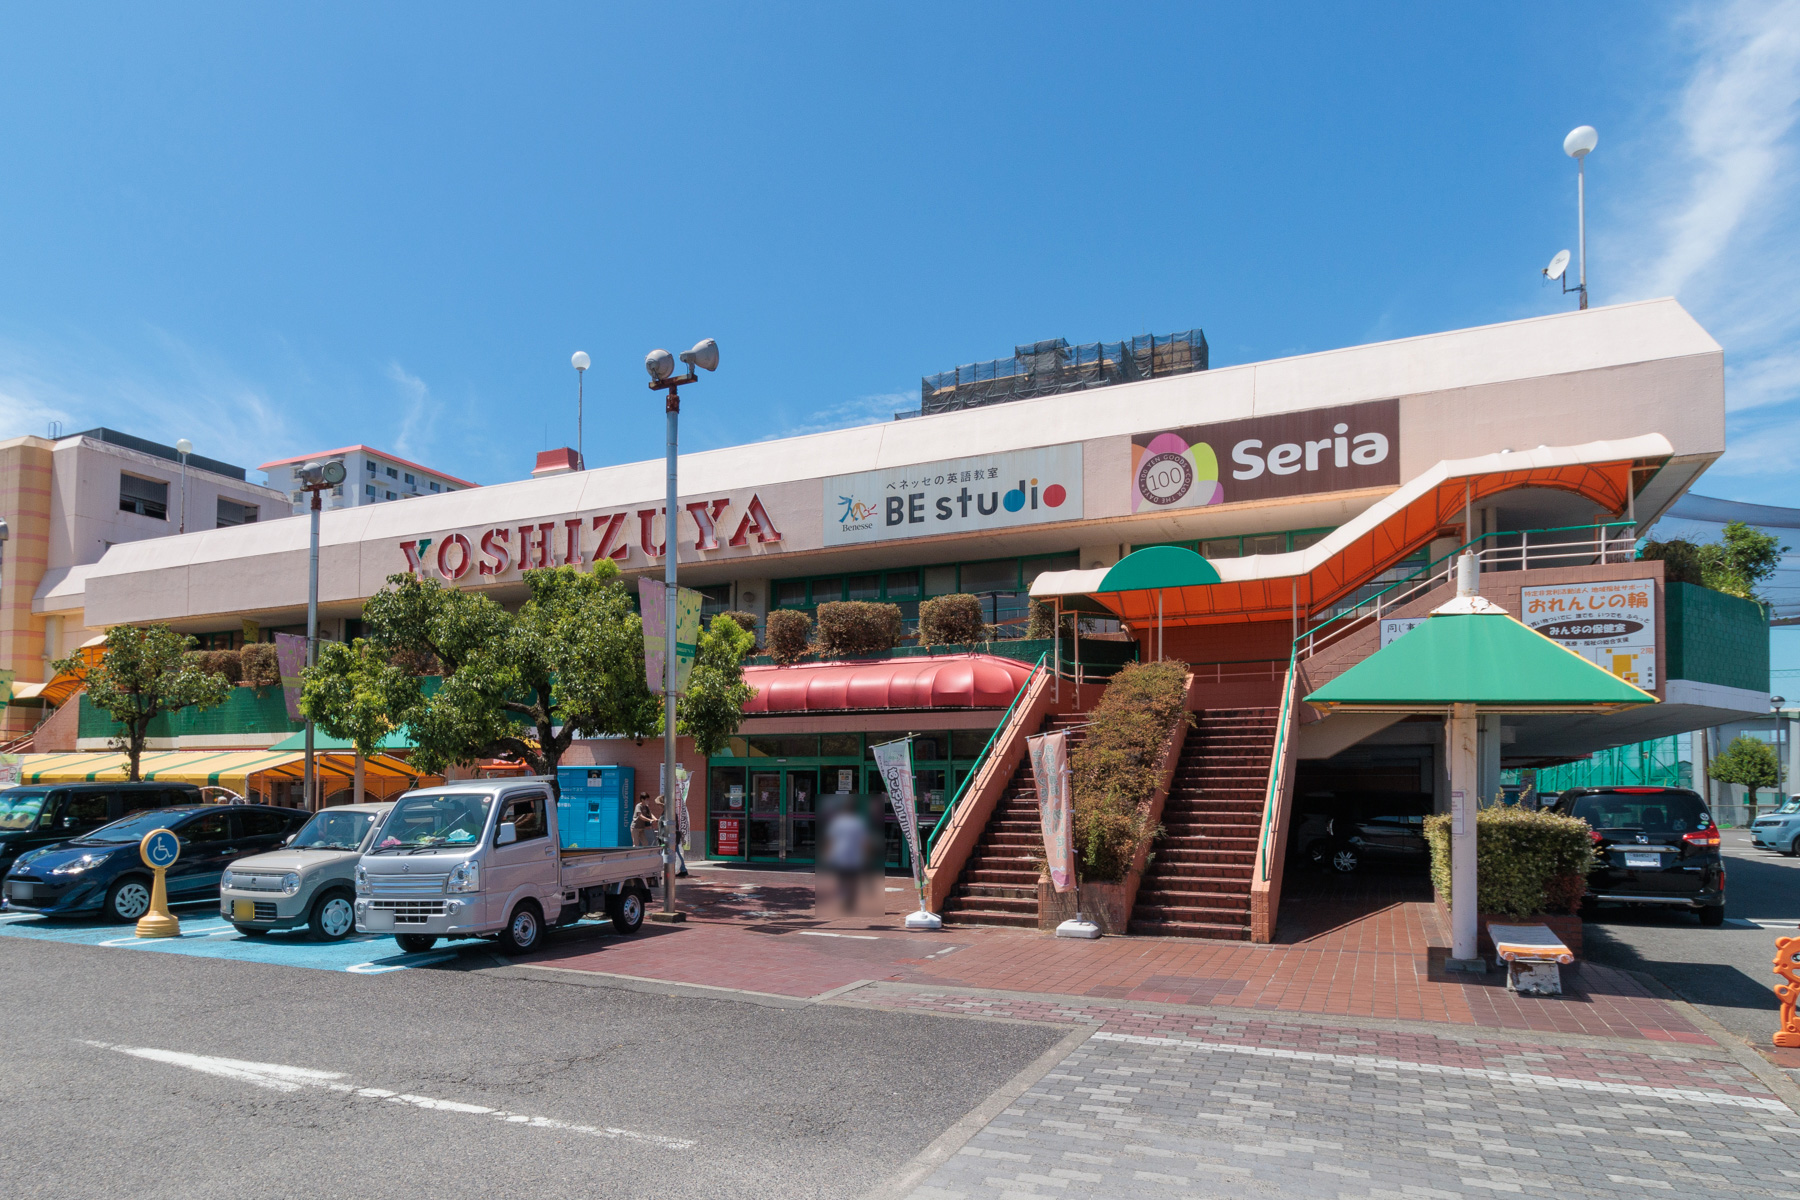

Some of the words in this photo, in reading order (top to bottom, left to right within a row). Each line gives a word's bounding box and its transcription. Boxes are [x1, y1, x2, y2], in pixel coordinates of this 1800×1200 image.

[1147, 456, 1160, 468] YEN
[1163, 454, 1188, 468] GOODS
[1231, 422, 1389, 481] Seria
[886, 467, 999, 491] ベネッセの英語教室
[1148, 467, 1182, 492] 100
[1177, 473, 1191, 497] COLOR
[885, 492, 925, 527] BE
[935, 477, 1067, 521] studio
[1142, 488, 1159, 503] DAYS
[1162, 495, 1176, 504] THE
[400, 493, 783, 582] YOSHIZUYA
[842, 522, 873, 532] Benesse
[1528, 591, 1649, 614] おれんじの輪
[1549, 623, 1626, 636] みんなの保健室
